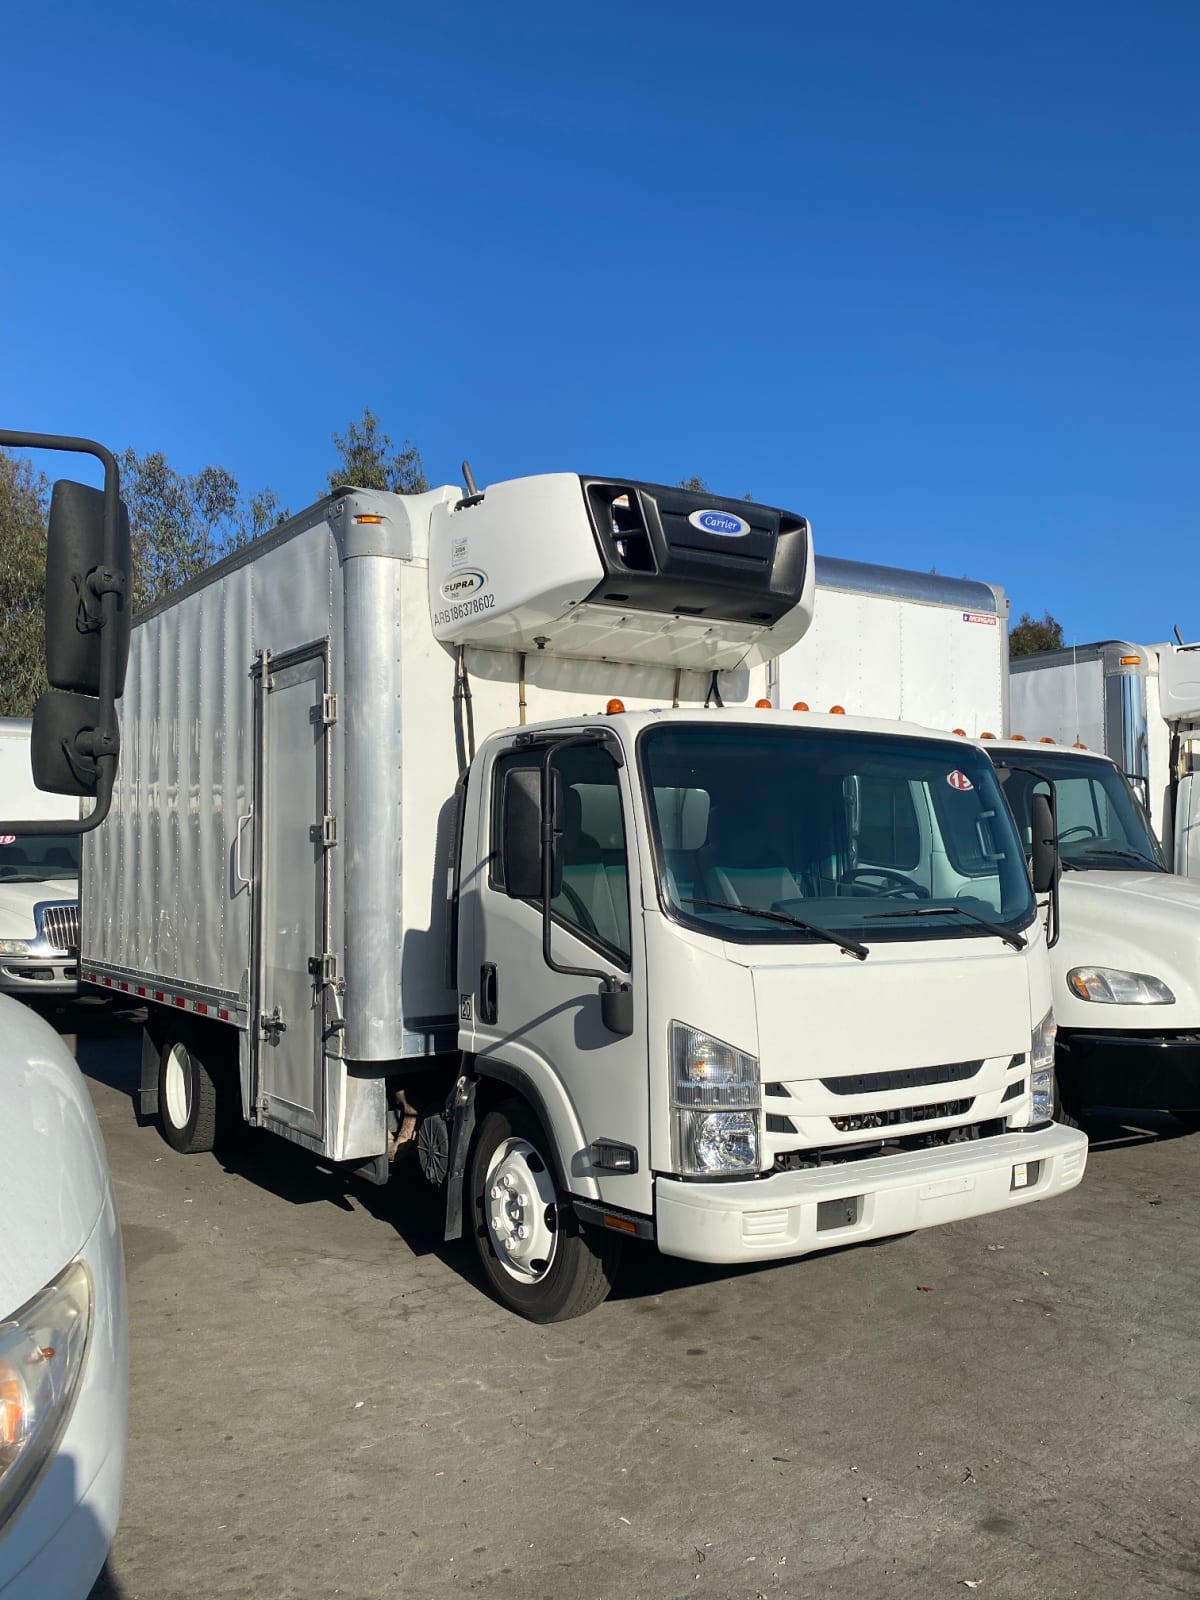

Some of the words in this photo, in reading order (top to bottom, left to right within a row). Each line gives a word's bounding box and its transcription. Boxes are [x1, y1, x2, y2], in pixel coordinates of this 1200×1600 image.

[705, 516, 738, 530] Carrier
[444, 579, 475, 593] SUPRA
[434, 594, 496, 627] ARB186378602
